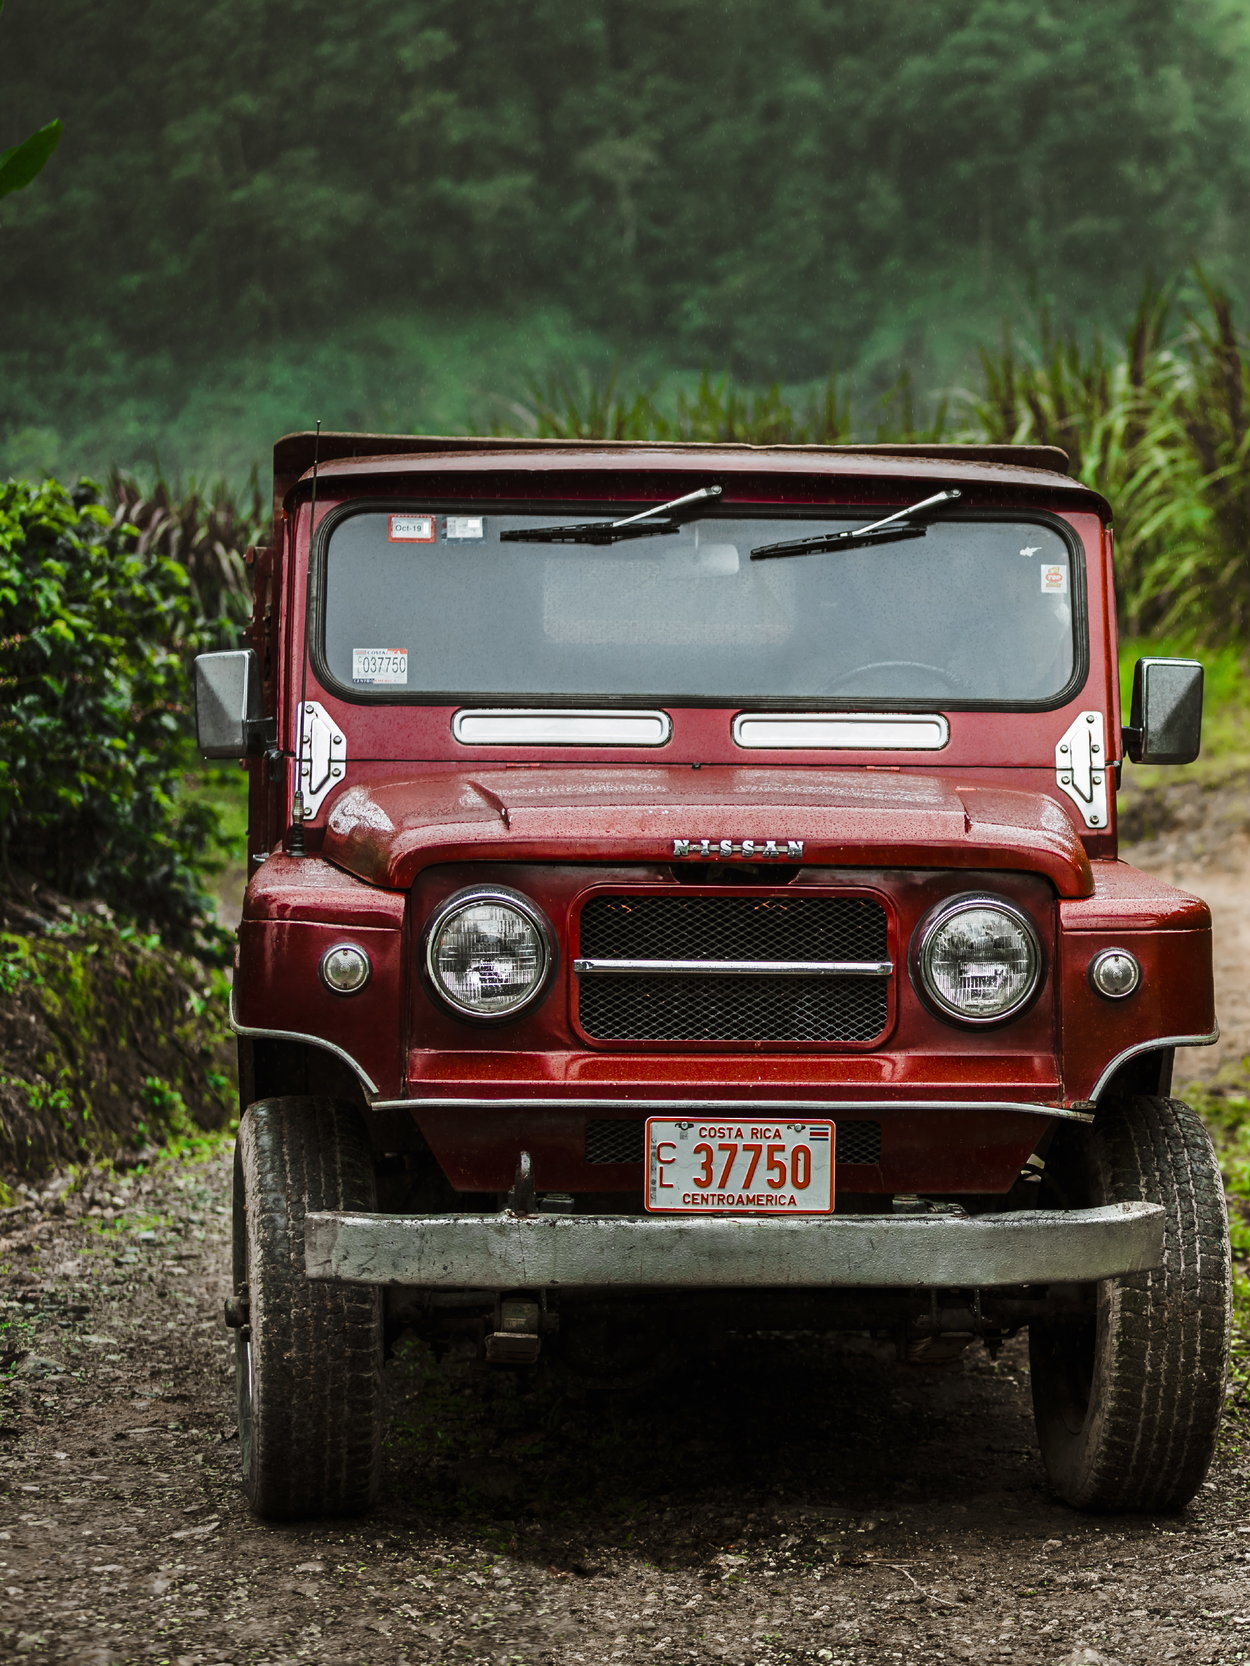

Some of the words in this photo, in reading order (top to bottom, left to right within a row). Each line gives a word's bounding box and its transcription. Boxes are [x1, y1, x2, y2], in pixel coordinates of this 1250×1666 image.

[363, 656, 406, 673] 037750
[673, 839, 803, 857] NISSAN
[699, 1126, 744, 1139] COSTA
[750, 1127, 782, 1139] RICA
[692, 1142, 812, 1190] 37750
[682, 1193, 797, 1206] CENTROAMERICA
